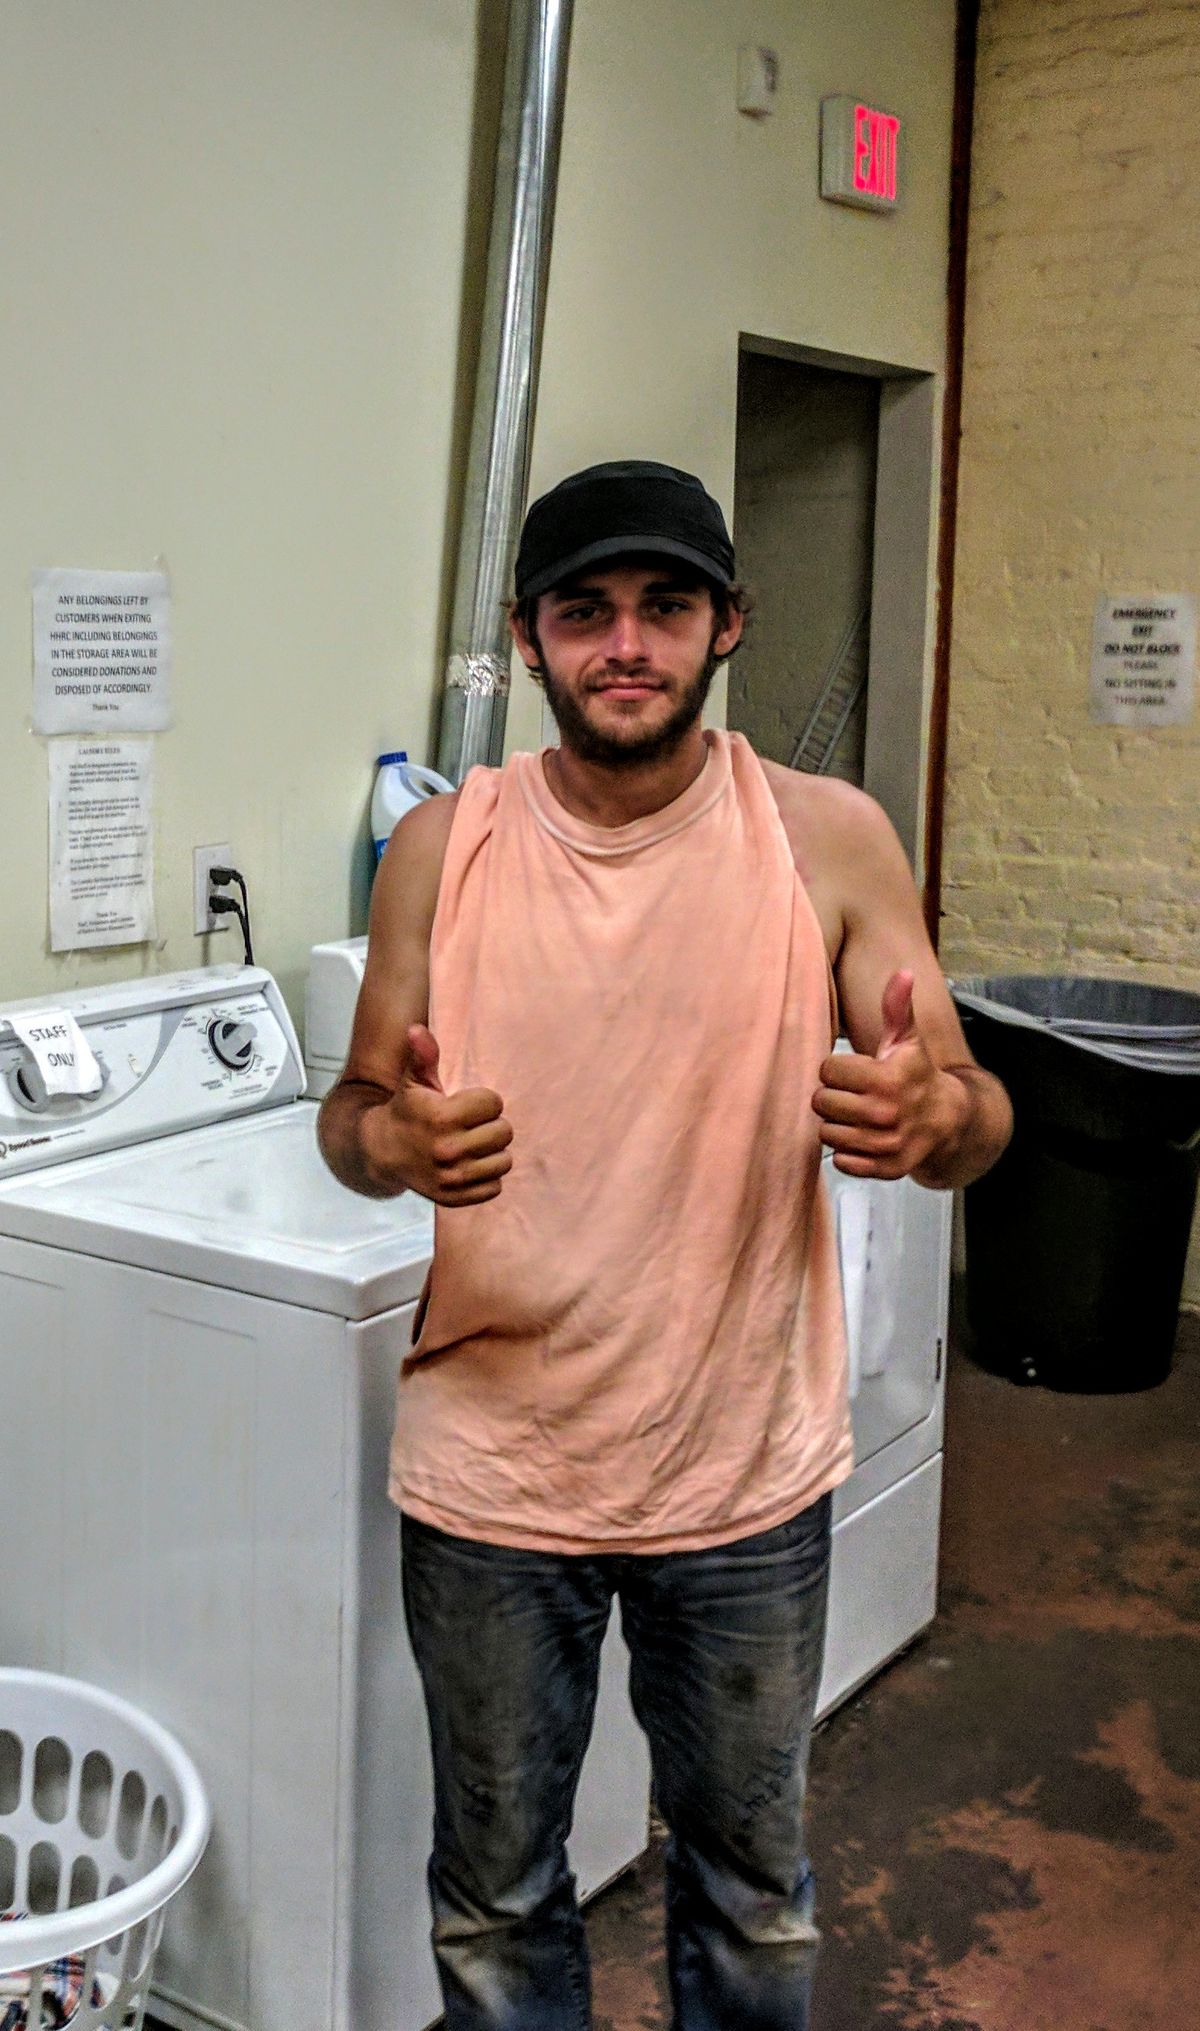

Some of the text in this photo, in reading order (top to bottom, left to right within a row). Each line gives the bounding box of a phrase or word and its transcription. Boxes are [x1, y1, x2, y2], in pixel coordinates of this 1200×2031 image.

[854, 105, 899, 201] EXIT
[59, 595, 149, 606] ANY BELONGINGS LEFT BY
[55, 613, 152, 623] CUSTOMERS WHEN EXITING
[1112, 608, 1176, 619] EMERGENCY
[50, 631, 158, 641] HHRC INCLUDING BELONGINGS
[51, 648, 158, 659] IN THE STORAGE AREA WILL BE
[51, 666, 157, 677] CONSIDERED DONATIONS AND
[55, 685, 91, 695] DISPOSED
[92, 684, 101, 694] OF
[28, 1024, 68, 1042] STAFF
